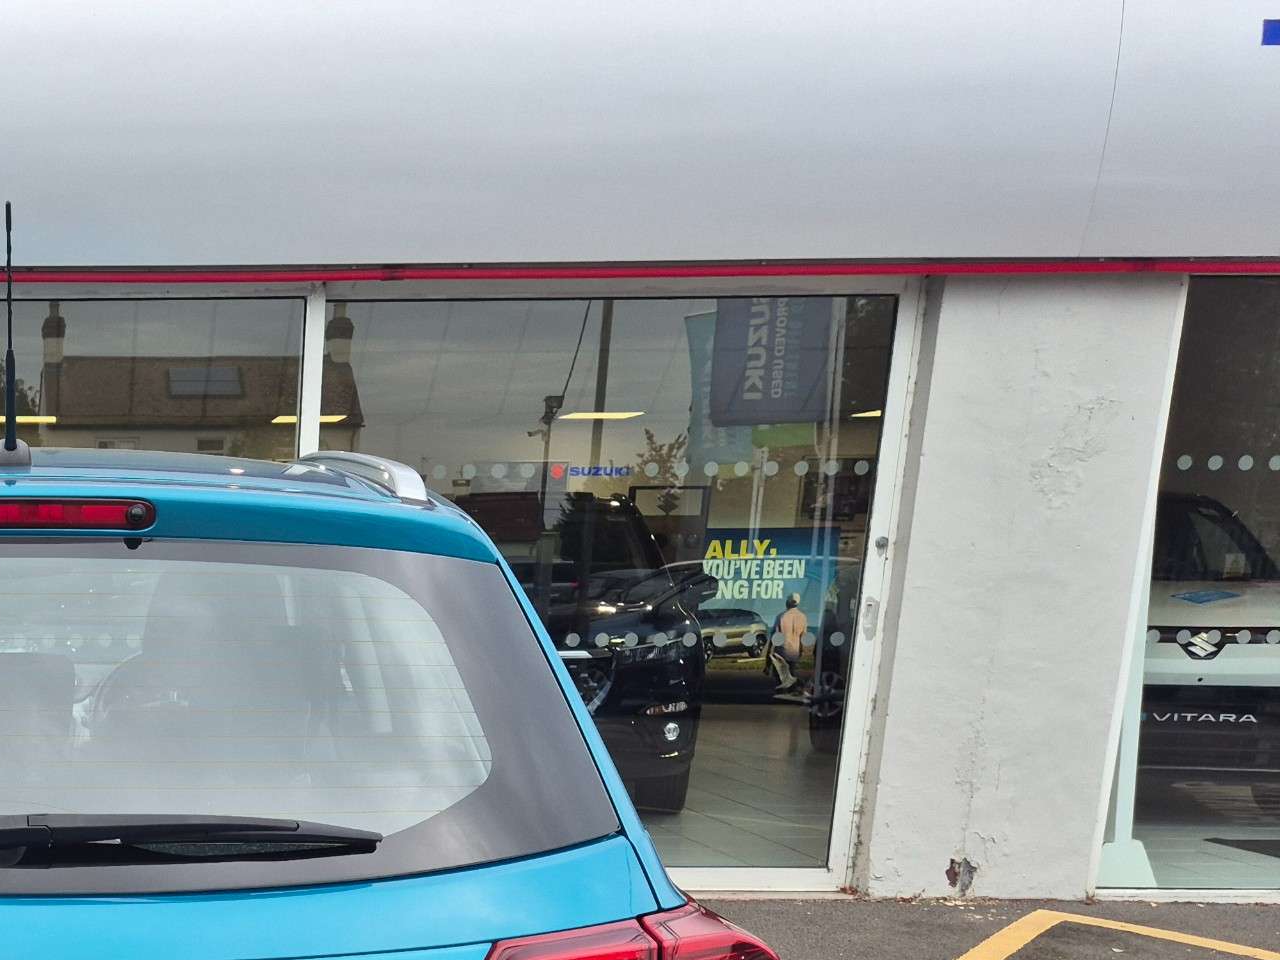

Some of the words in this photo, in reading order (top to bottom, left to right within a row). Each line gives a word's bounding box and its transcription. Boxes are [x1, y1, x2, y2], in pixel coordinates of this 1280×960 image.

[568, 466, 636, 477] SUZUKI
[762, 560, 805, 579] BEEN
[751, 580, 784, 599] FOR
[1152, 712, 1259, 724] VITARA
